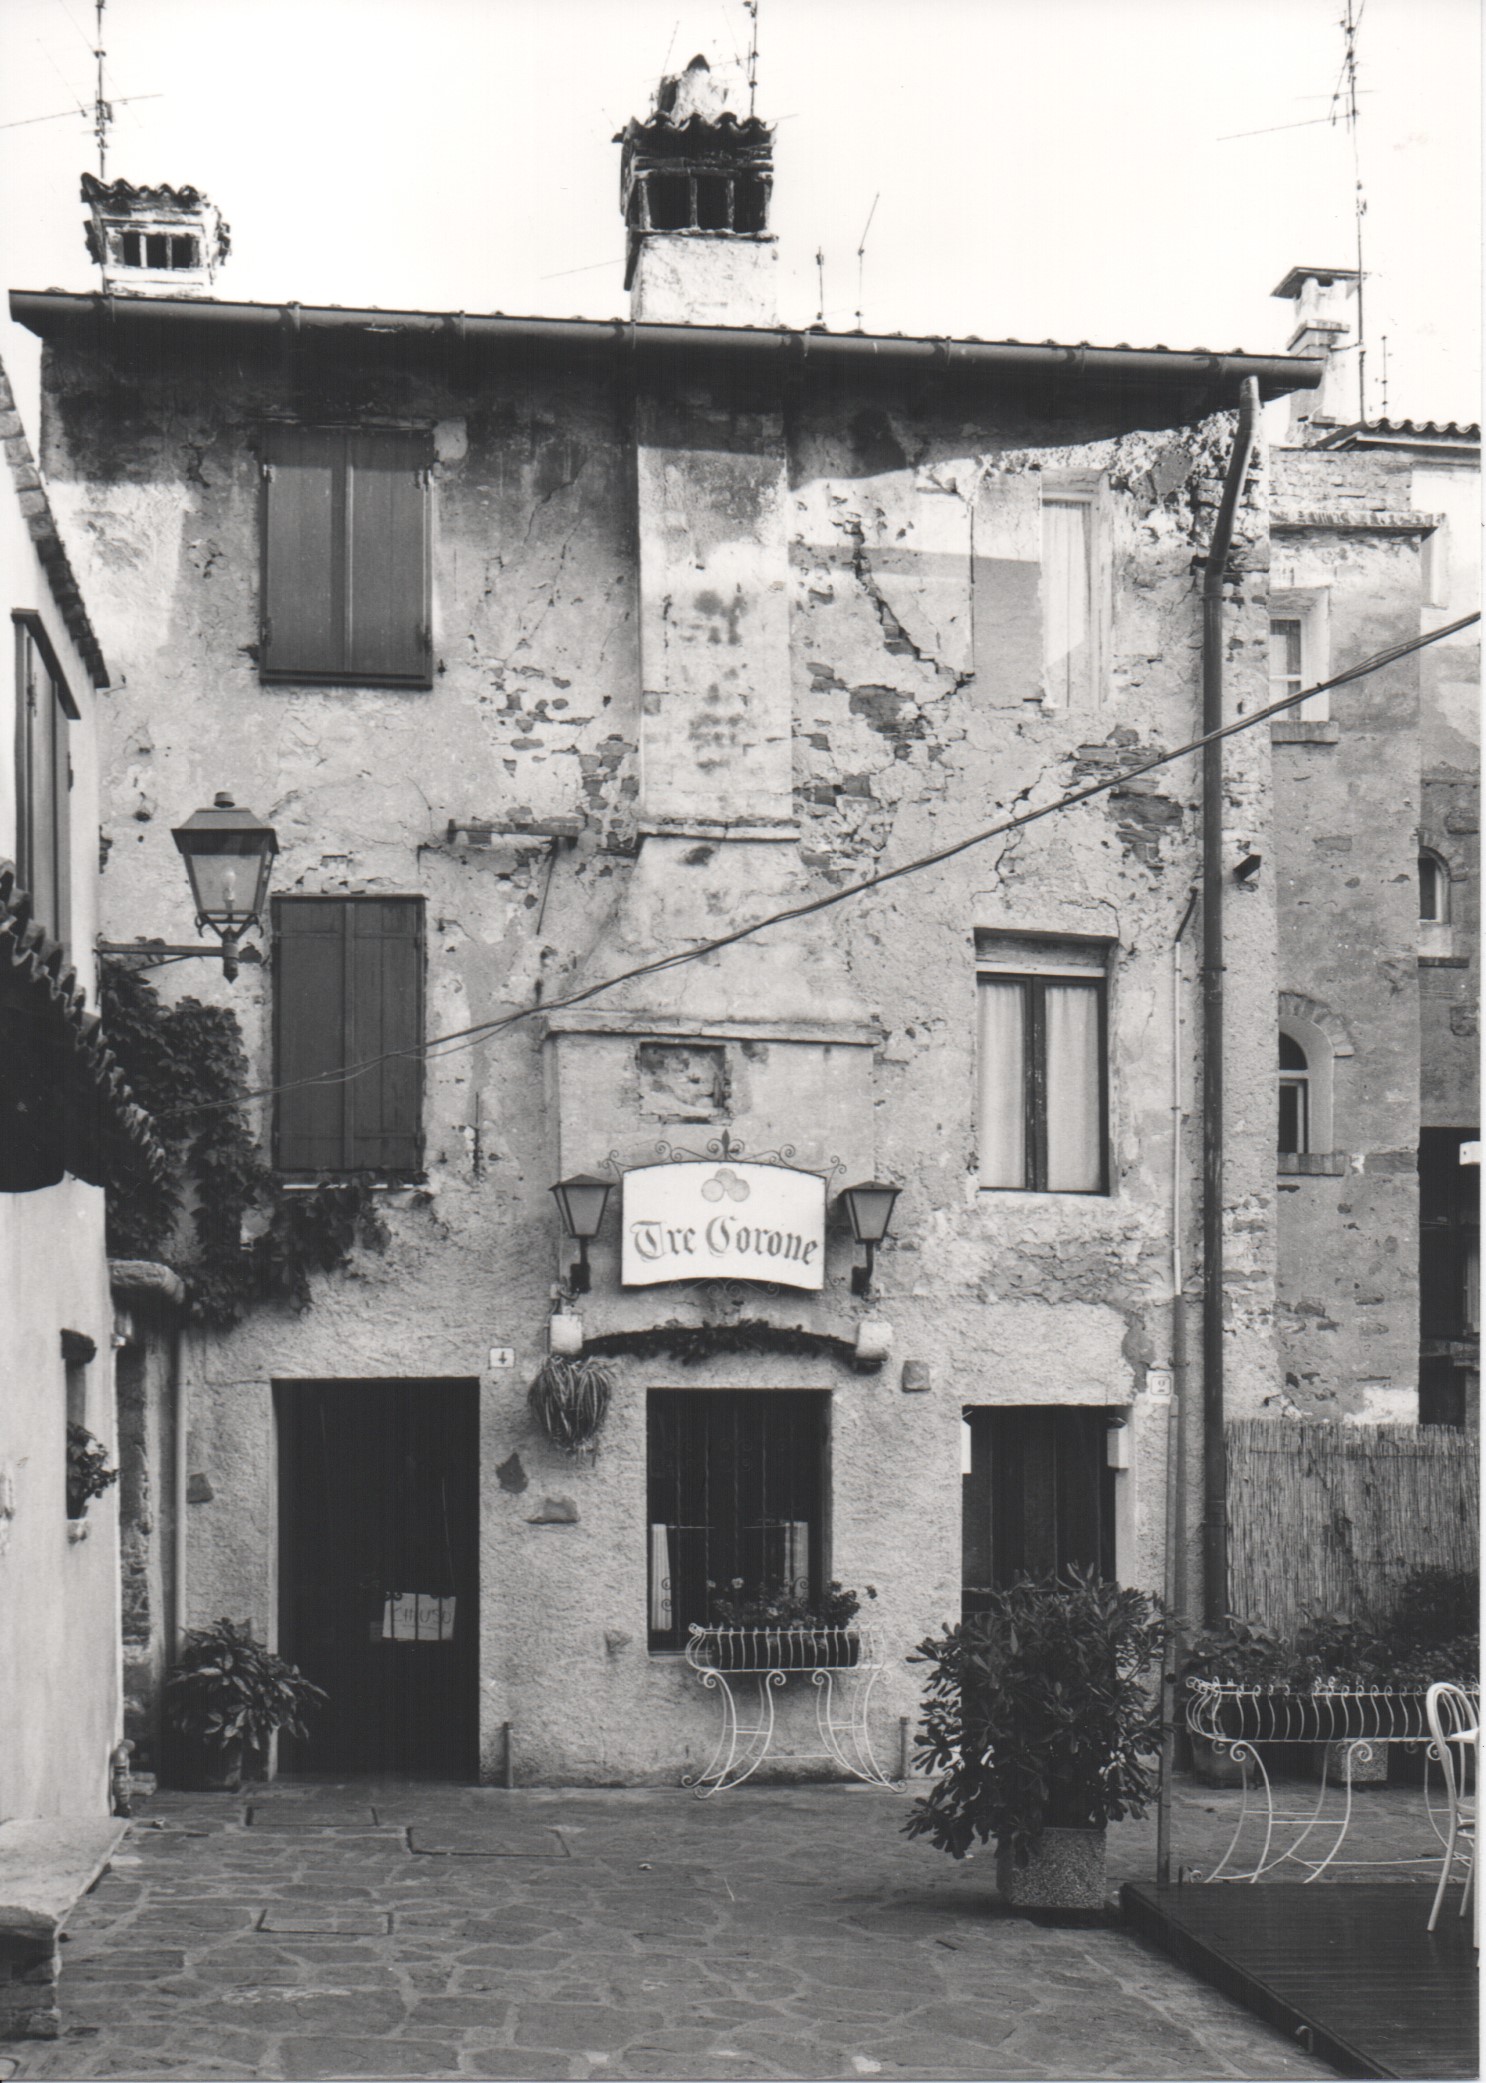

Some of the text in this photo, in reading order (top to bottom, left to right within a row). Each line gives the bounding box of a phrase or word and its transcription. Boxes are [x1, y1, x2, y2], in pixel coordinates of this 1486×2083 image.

[630, 1215, 818, 1265] Tre Corone
[498, 1350, 508, 1365] 4
[393, 1606, 452, 1625] CHUSO
